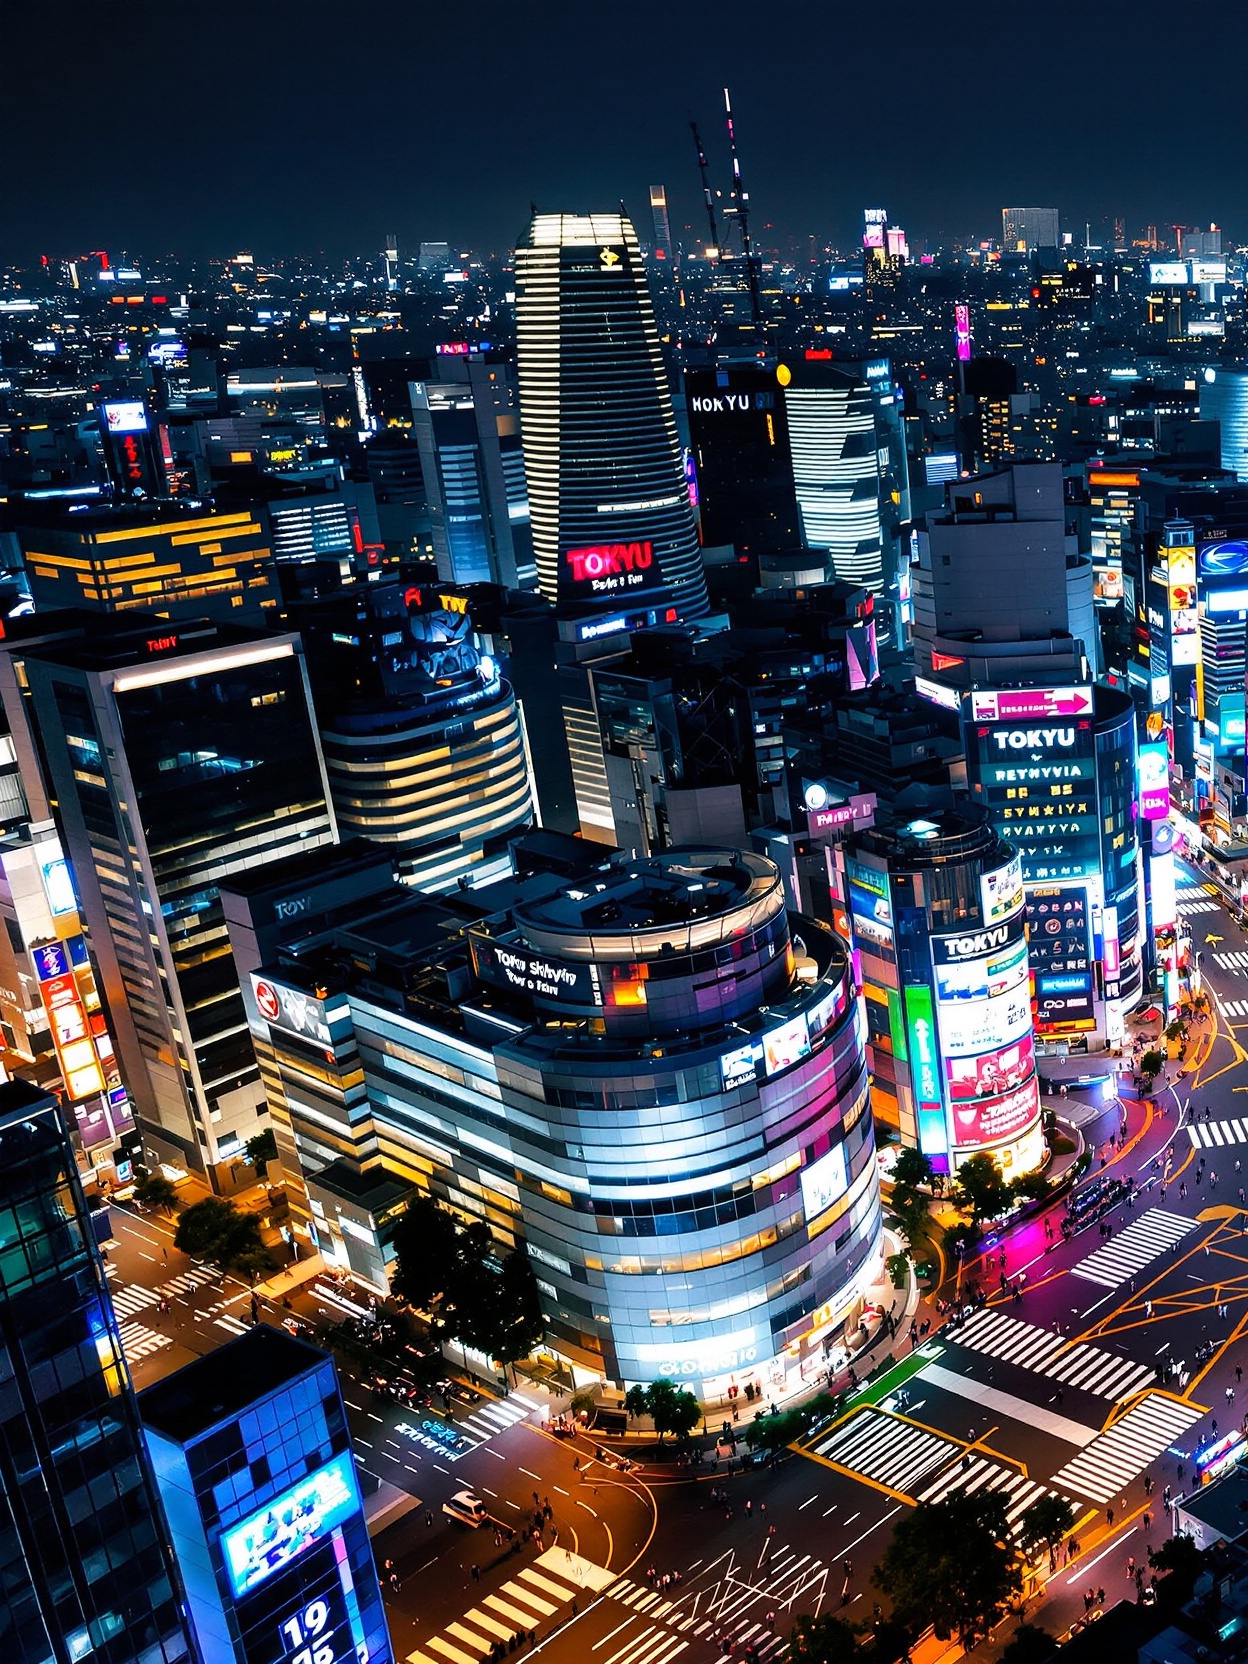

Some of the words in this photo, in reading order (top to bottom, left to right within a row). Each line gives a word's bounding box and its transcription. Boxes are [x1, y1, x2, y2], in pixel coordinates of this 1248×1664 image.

[566, 541, 652, 581] TOKYU
[993, 727, 1075, 749] TOKYU
[944, 925, 1009, 956] TOKYU
[284, 1600, 328, 1649] 19
